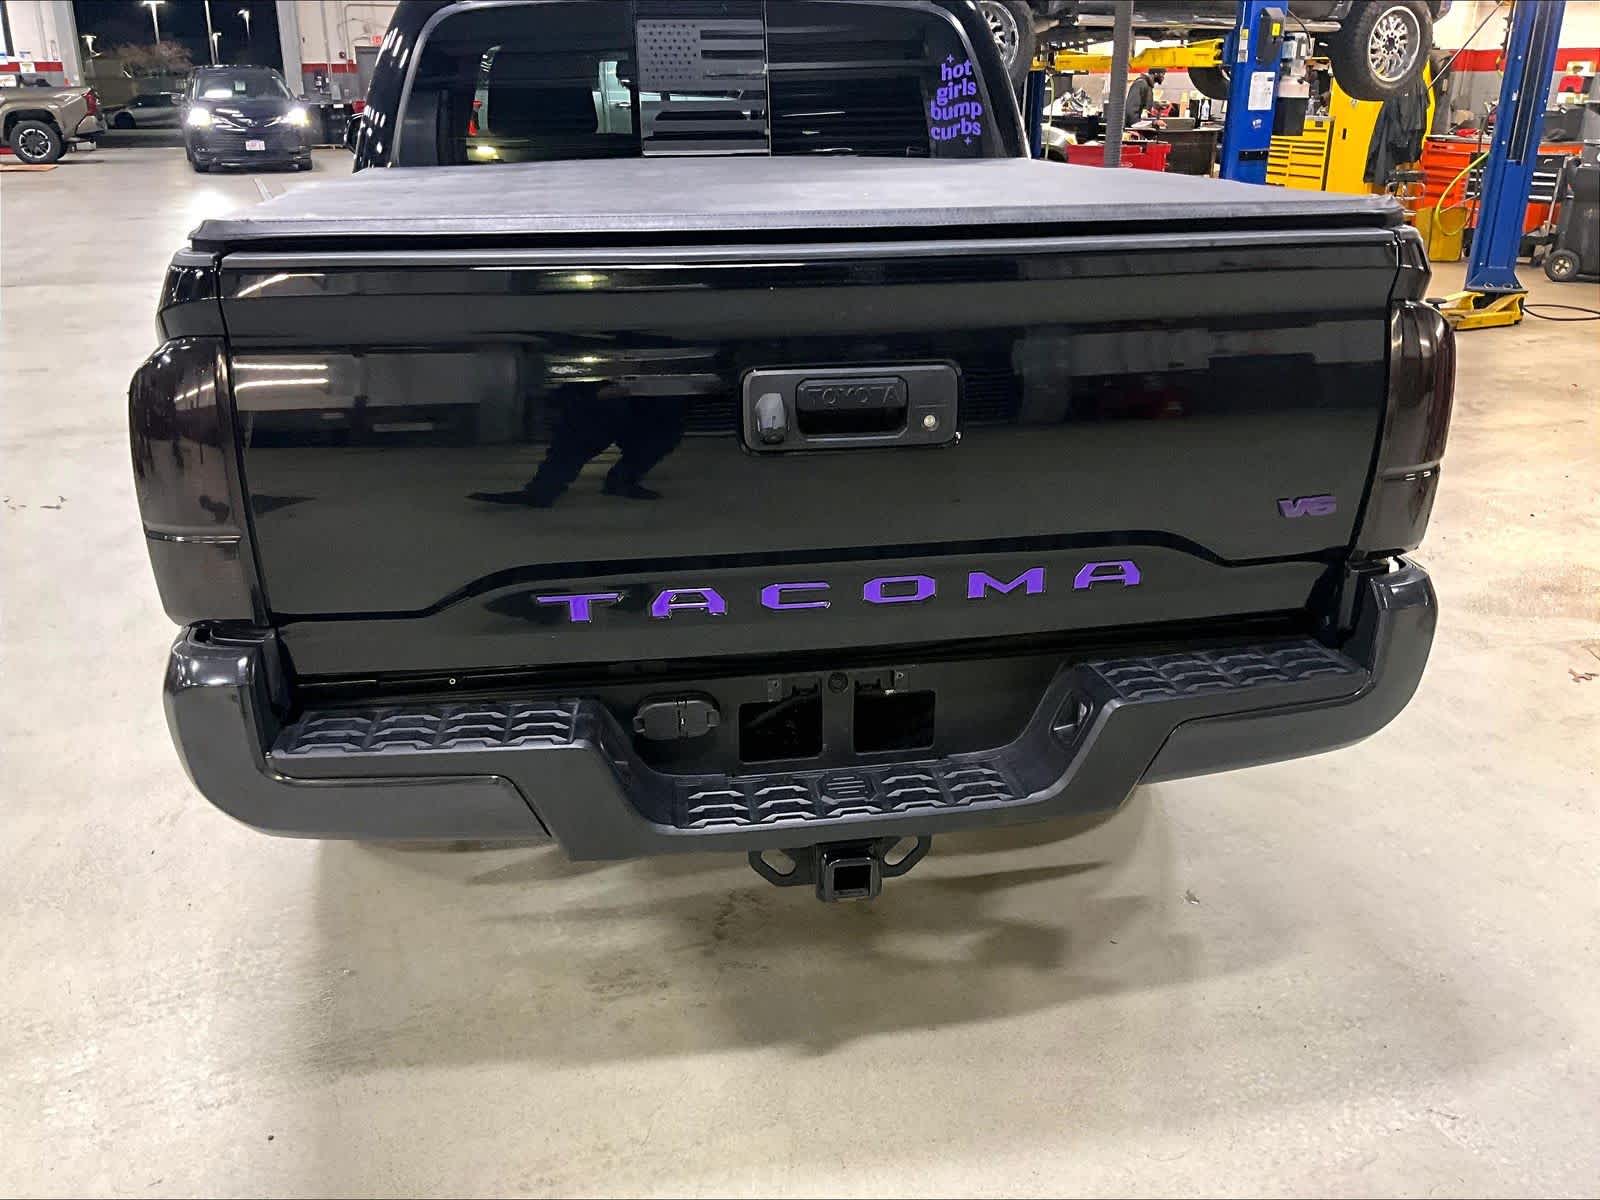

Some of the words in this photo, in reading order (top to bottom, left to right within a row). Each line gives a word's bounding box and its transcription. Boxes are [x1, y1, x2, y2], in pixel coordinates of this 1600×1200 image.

[941, 59, 972, 81] hot
[936, 78, 977, 106] girls
[930, 99, 982, 120] bump
[930, 118, 981, 140] curbs
[1278, 495, 1337, 518] V6
[535, 558, 1142, 624] TACOMA
